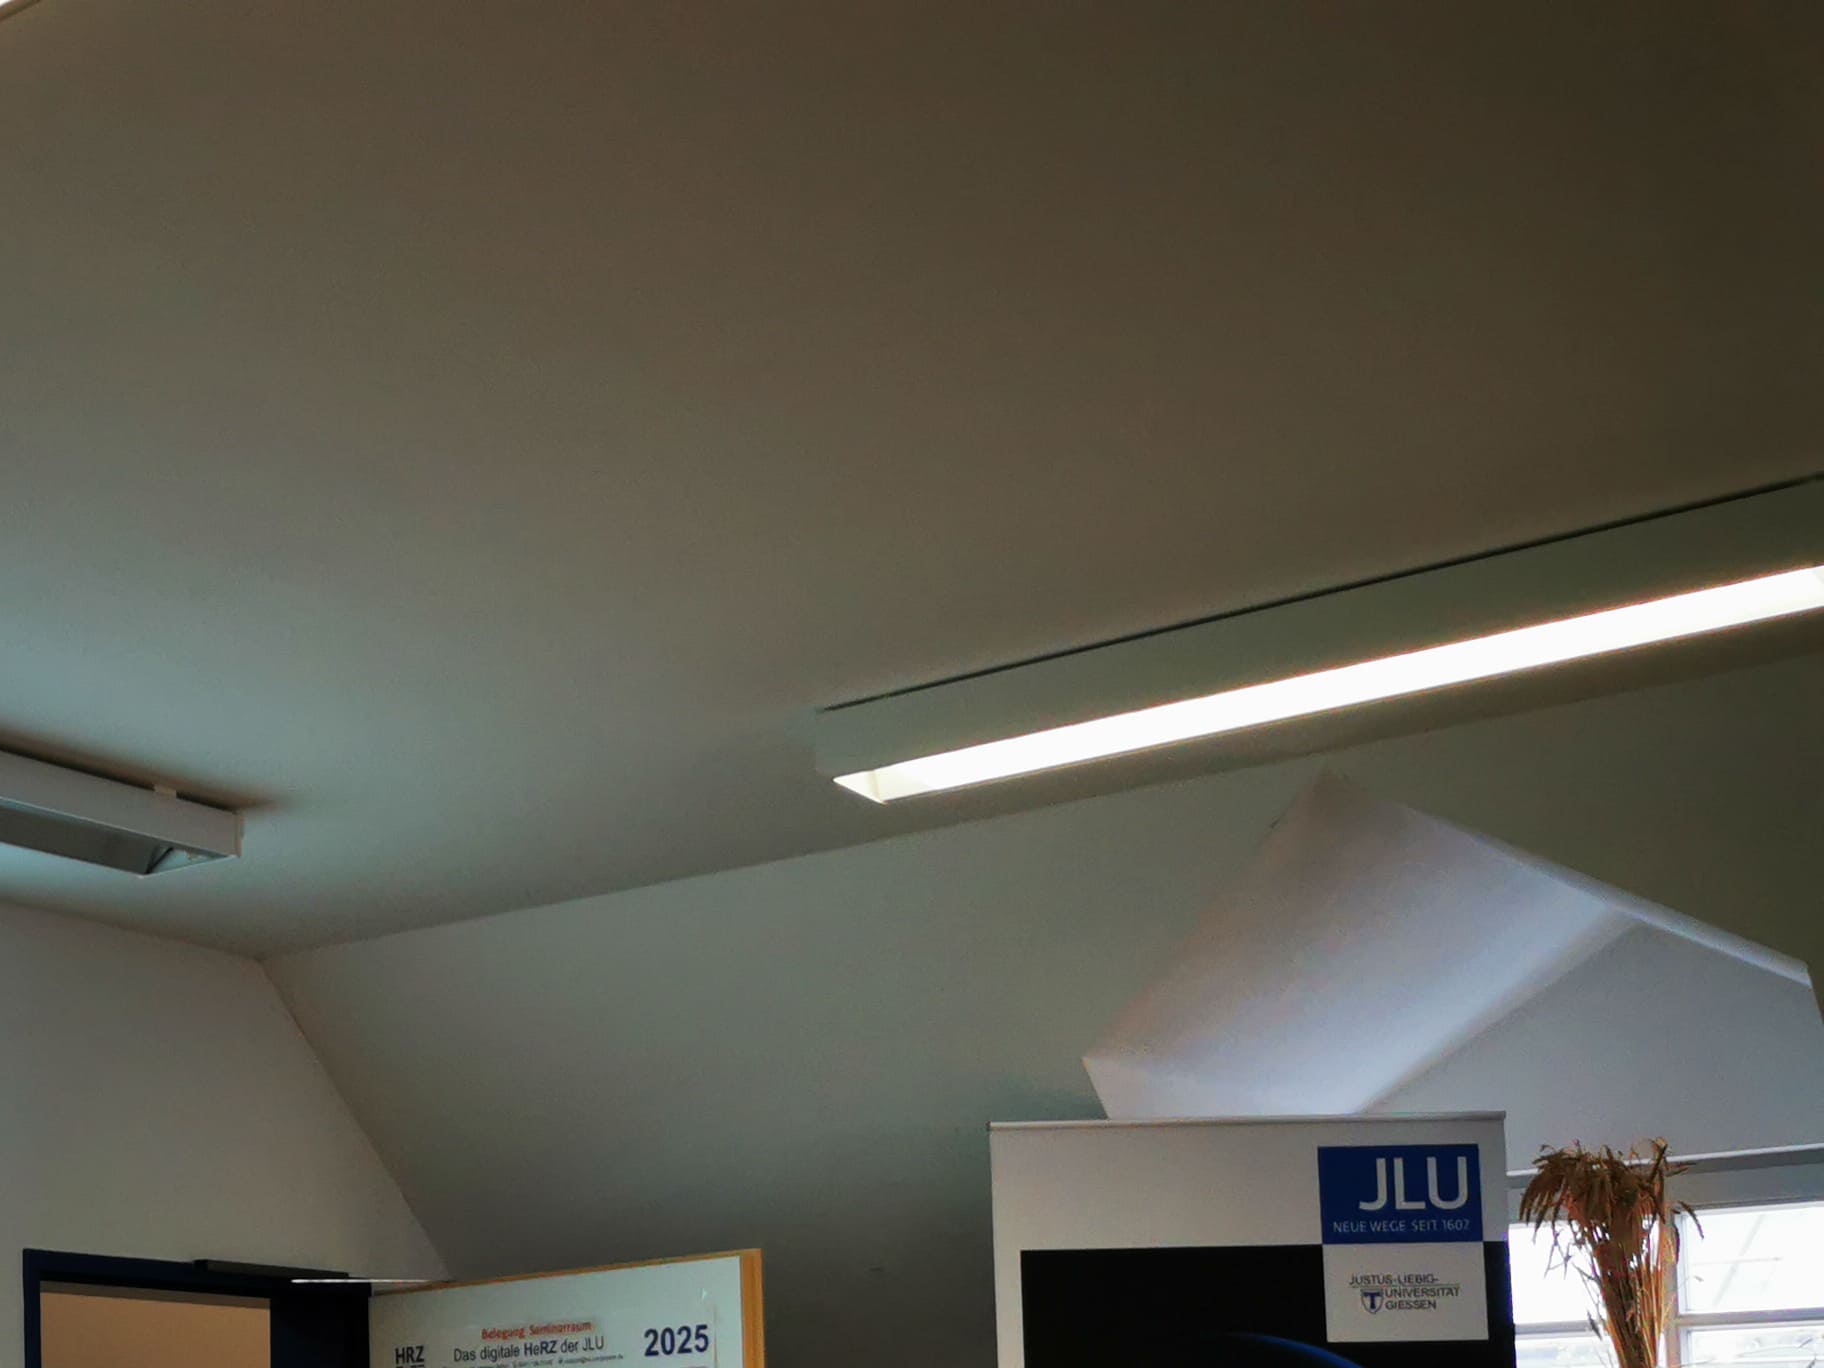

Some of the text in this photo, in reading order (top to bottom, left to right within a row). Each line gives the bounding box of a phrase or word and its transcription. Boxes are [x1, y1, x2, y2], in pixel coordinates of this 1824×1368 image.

[1358, 1156, 1469, 1211] JLU
[1333, 1220, 1367, 1233] NEUE
[1369, 1220, 1406, 1232] WEGE
[1411, 1219, 1438, 1232] SEIT
[1385, 1299, 1437, 1311] GIESSEN
[453, 1335, 605, 1363] Das digitale HeRZ der JLU
[644, 1324, 709, 1358] 2025
[394, 1345, 425, 1365] HRZ
